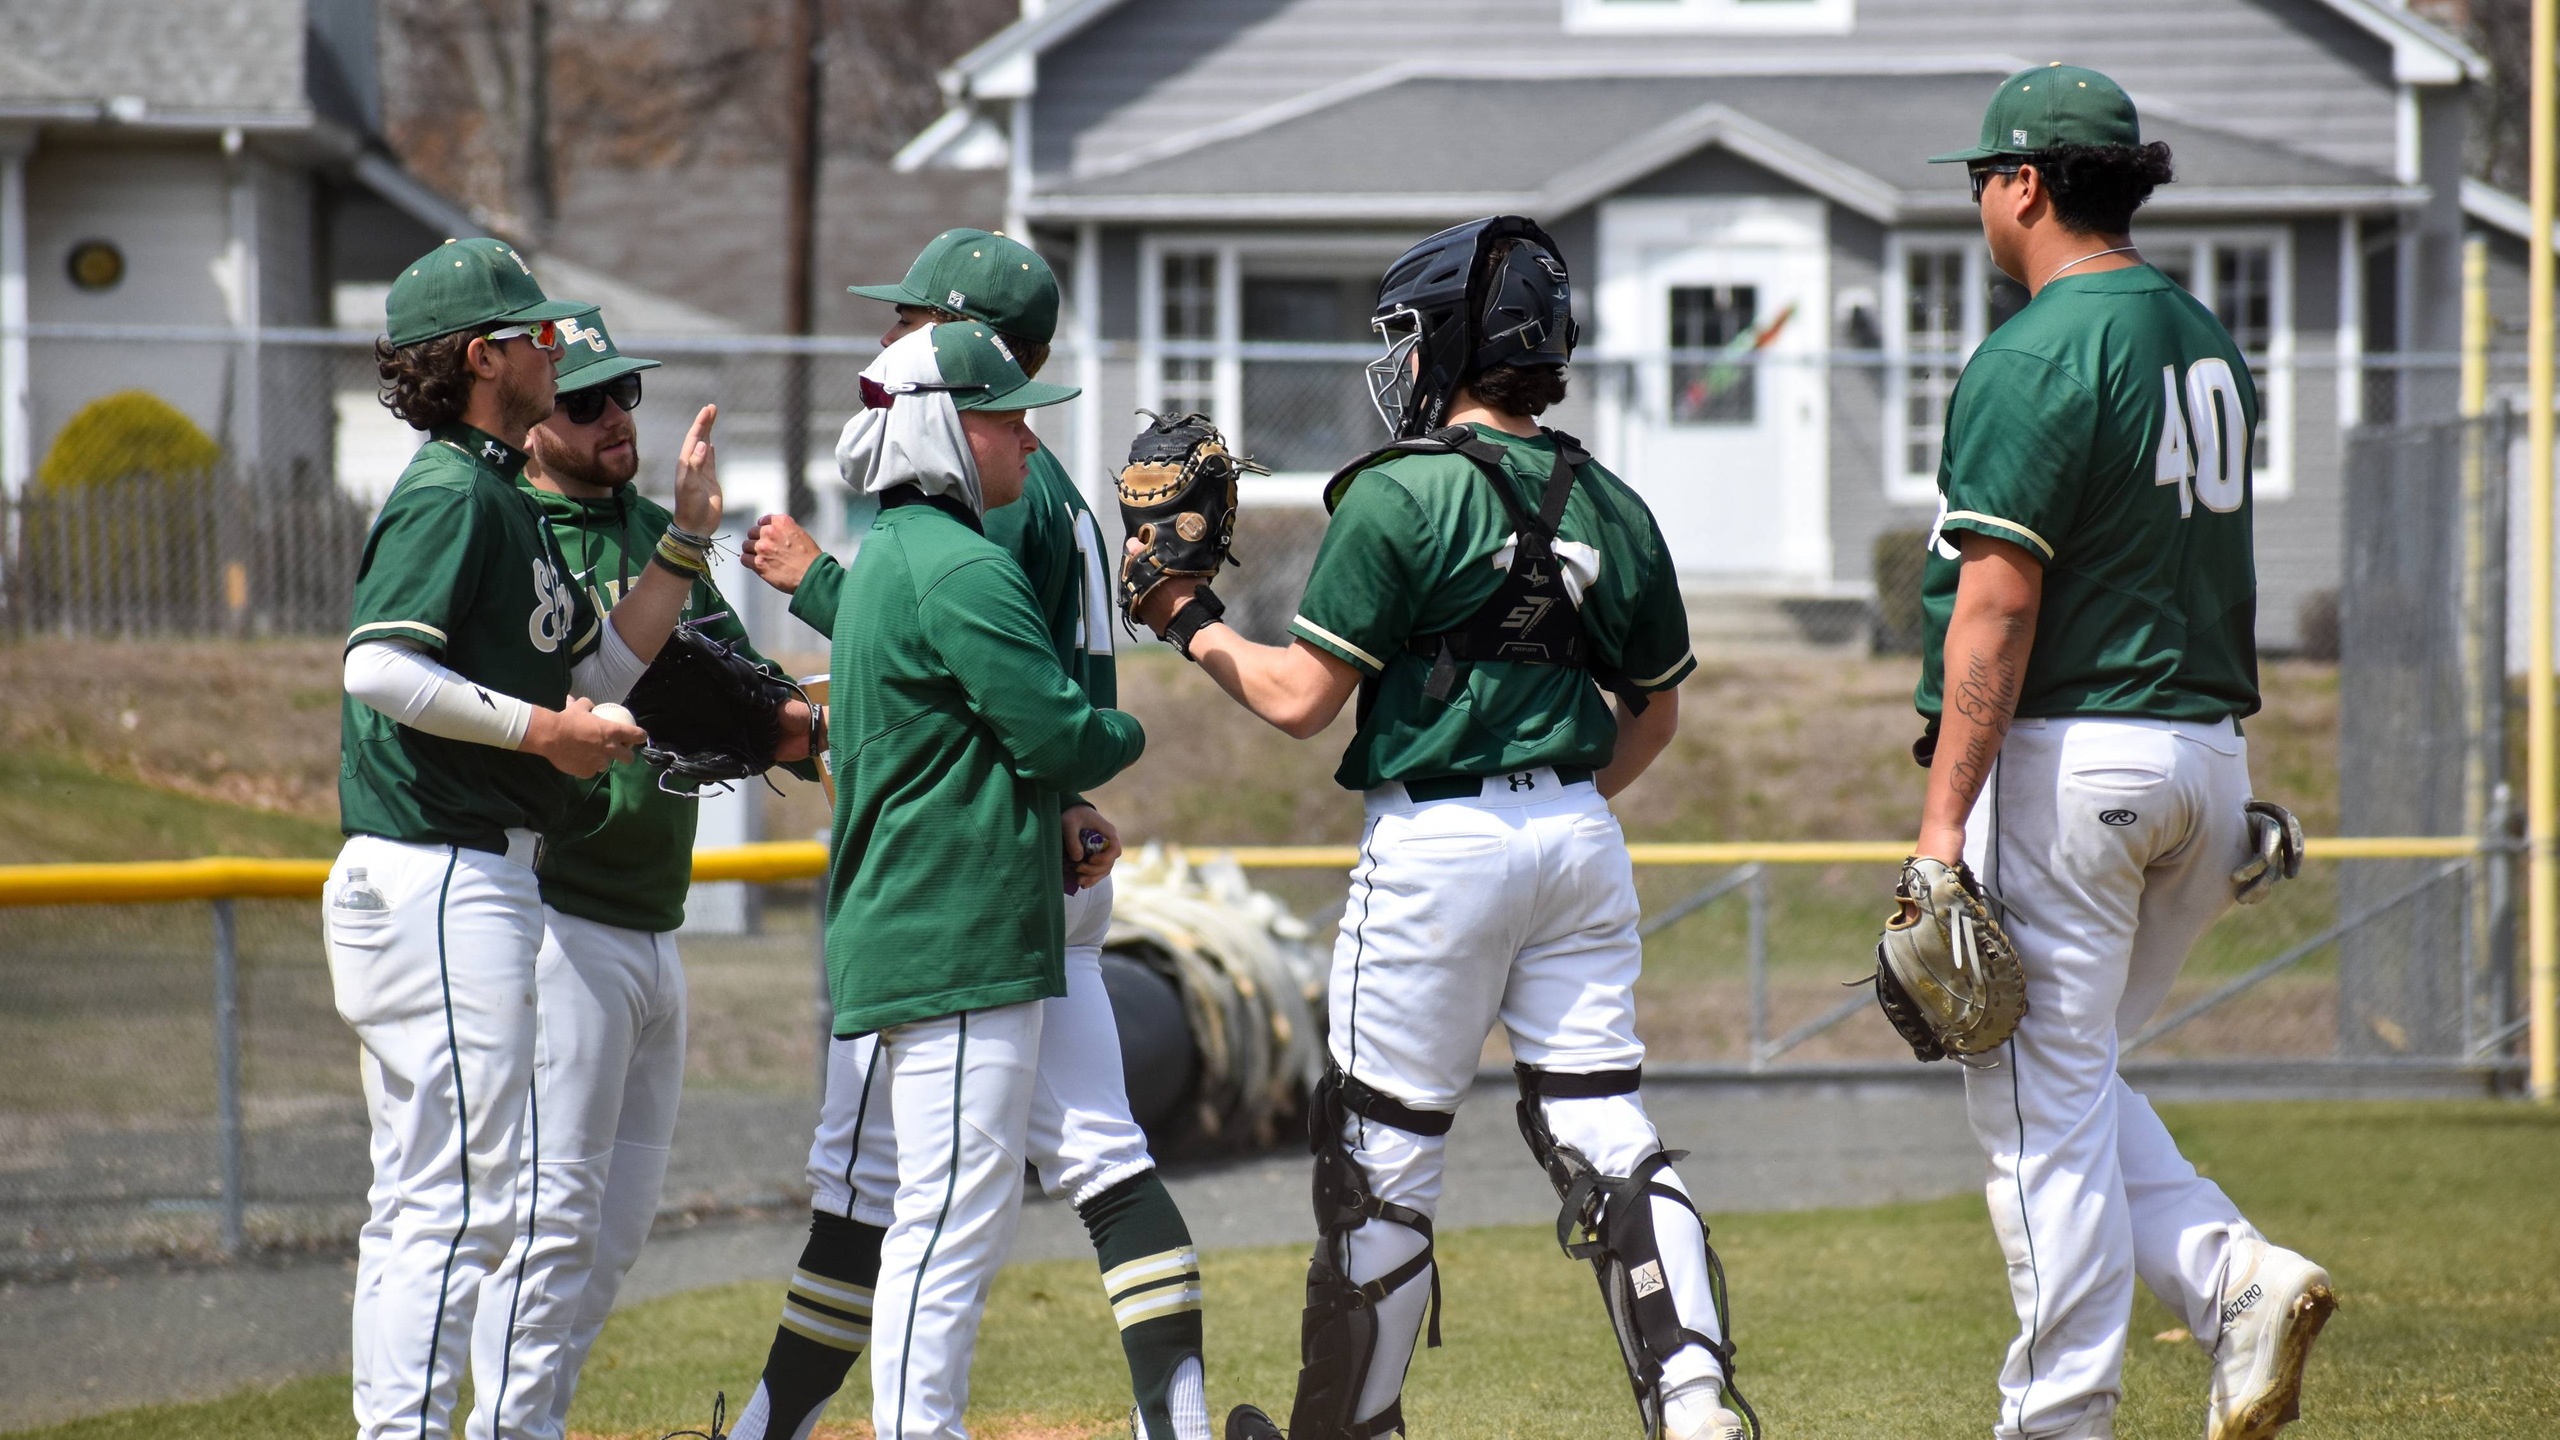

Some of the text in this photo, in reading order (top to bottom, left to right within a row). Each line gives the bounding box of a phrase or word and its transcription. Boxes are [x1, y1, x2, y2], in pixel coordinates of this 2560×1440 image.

[554, 317, 607, 353] EC
[2155, 357, 2248, 519] 40
[1064, 501, 1113, 656] 1
